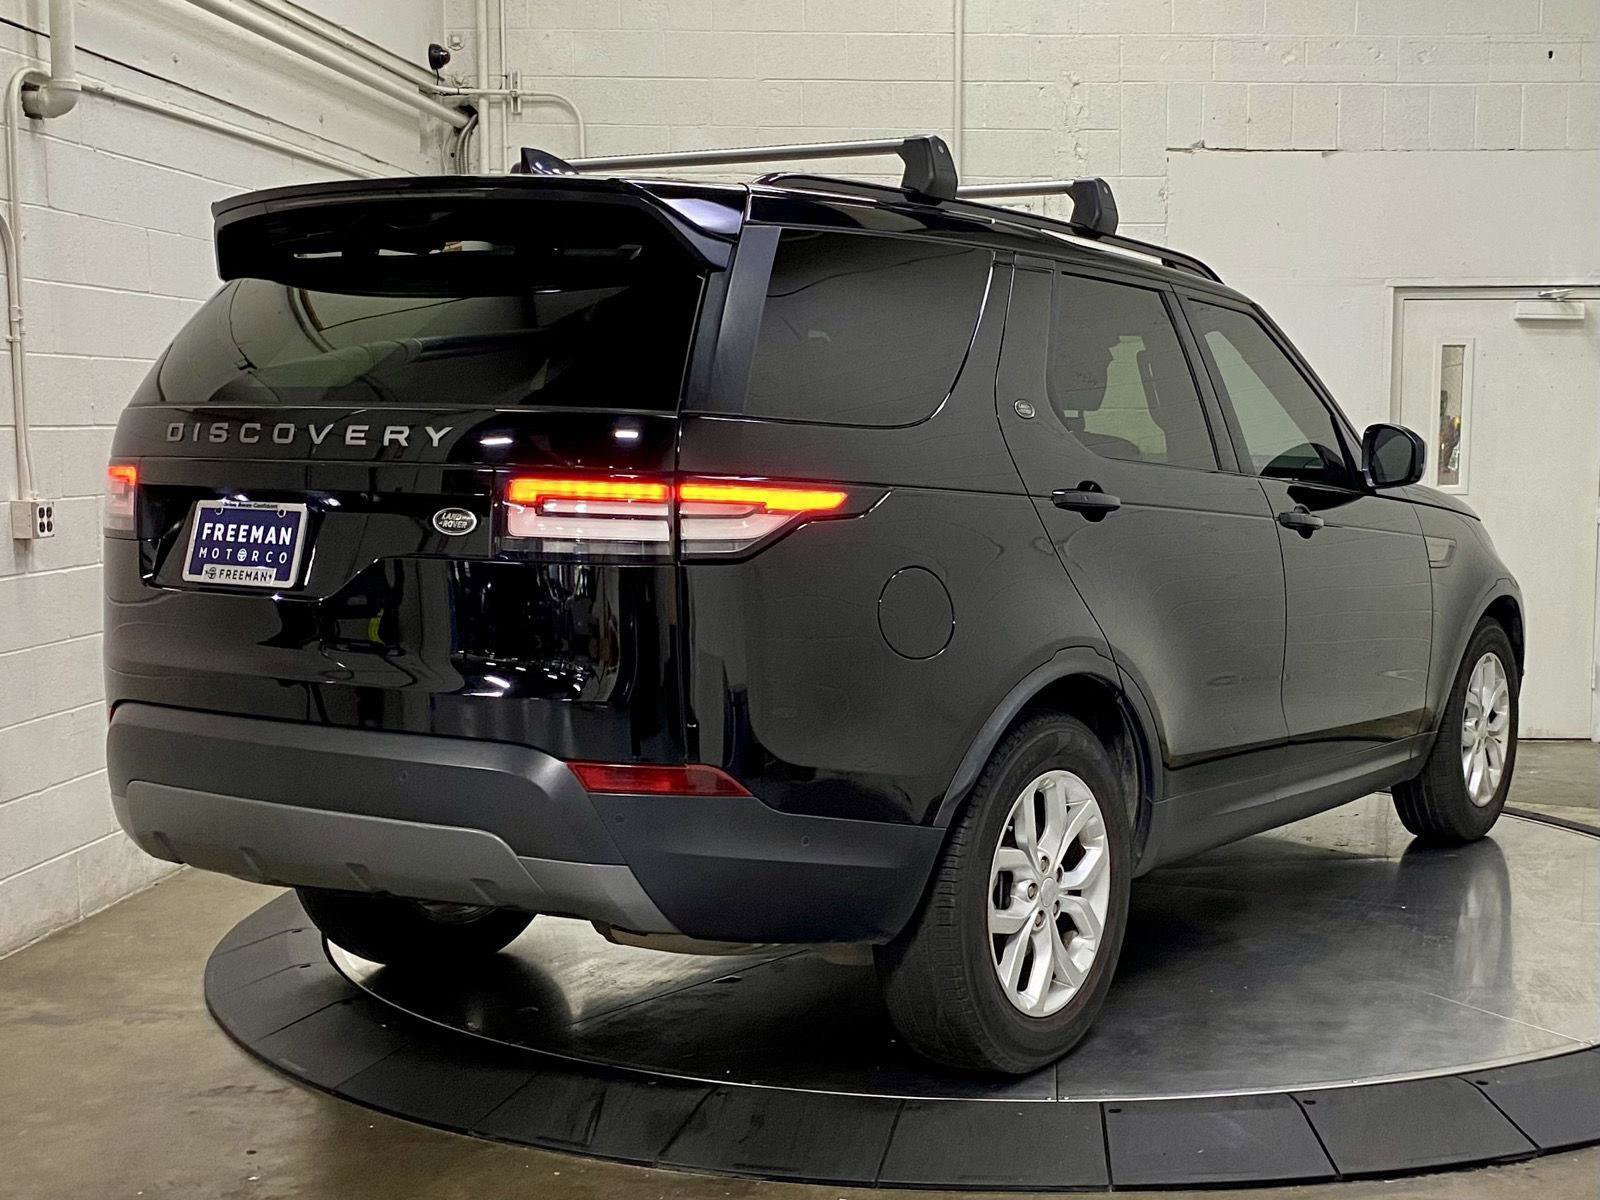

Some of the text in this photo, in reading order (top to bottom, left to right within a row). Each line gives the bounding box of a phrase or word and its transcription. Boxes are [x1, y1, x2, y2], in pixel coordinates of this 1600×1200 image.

[165, 422, 454, 448] DISCOVERY
[441, 512, 462, 520] LAND
[442, 520, 468, 529] ROVER
[202, 522, 292, 545] FREEMAN
[198, 546, 288, 564] MOTORCO
[219, 568, 268, 582] FREEMAN
